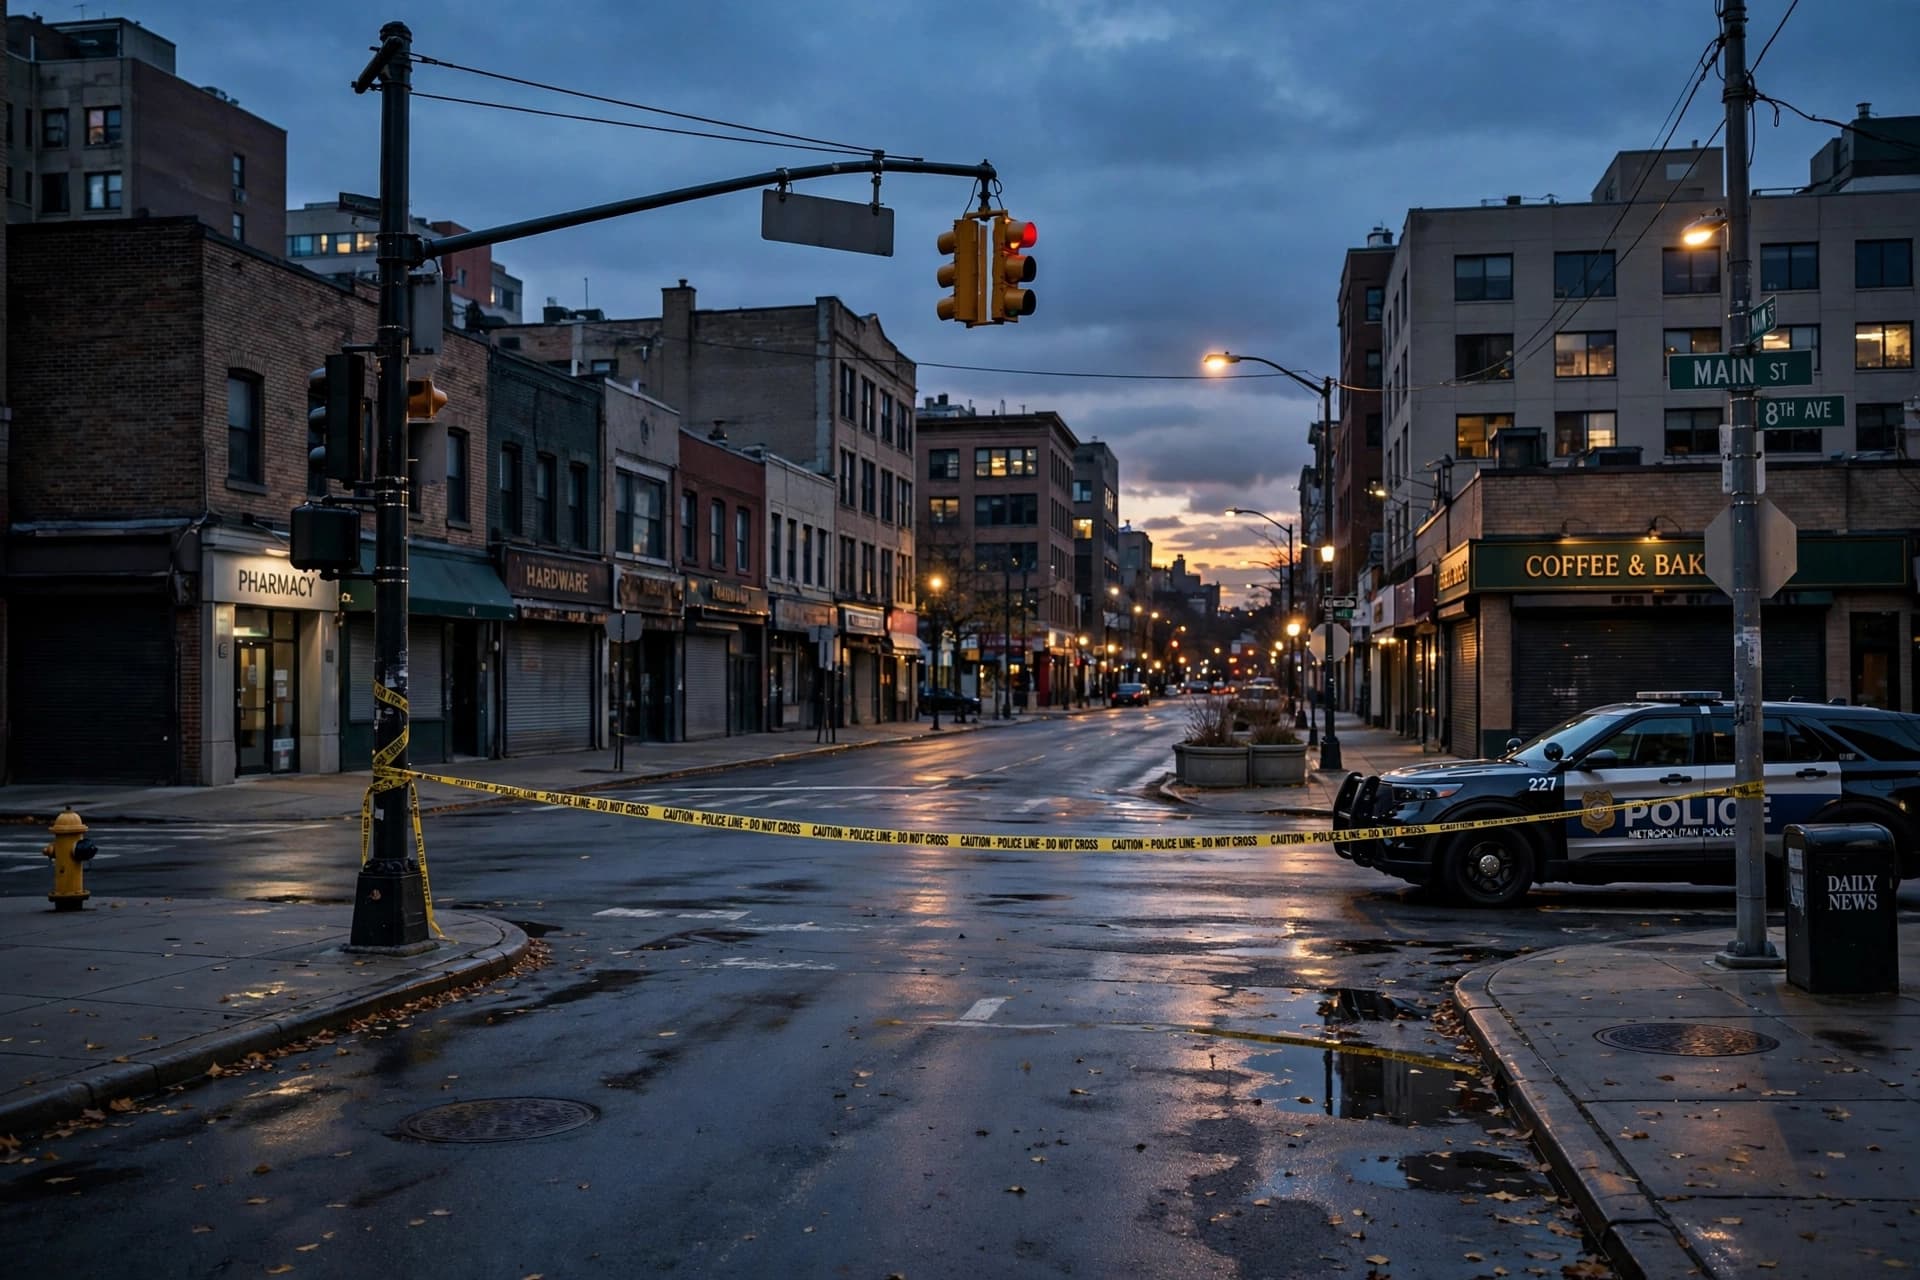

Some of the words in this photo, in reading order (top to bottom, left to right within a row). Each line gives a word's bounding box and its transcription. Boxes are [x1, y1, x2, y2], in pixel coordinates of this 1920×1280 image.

[1694, 358, 1754, 385] MAIN
[1769, 362, 1788, 381] ST
[1765, 401, 1795, 426] 8TH
[1804, 401, 1832, 419] AVE
[1525, 553, 1620, 577] COFFEE
[1627, 553, 1646, 576] &
[1655, 553, 1705, 577] BAK
[238, 569, 315, 597] PHARMACY
[526, 565, 589, 593] HARDWARE
[1528, 777, 1557, 792] 227
[546, 792, 572, 806] POLICE
[574, 796, 590, 808] LINE
[597, 800, 608, 811] DO
[608, 801, 623, 813] NOT
[626, 803, 649, 816] CROSS
[664, 809, 694, 822] CAUTION
[702, 813, 725, 826] POLICE
[728, 816, 743, 828] LINE
[750, 819, 760, 830] DO
[762, 820, 777, 832] NOT
[778, 823, 800, 834] CROSS
[812, 826, 842, 838] CAUTION
[850, 829, 874, 842] POLICE
[876, 831, 891, 842] LINE
[898, 833, 907, 843] DO
[909, 833, 924, 844] NOT
[926, 834, 948, 846] CROSS
[960, 836, 990, 848] CAUTION
[998, 837, 1022, 848] POLICE
[1024, 838, 1040, 849] LINE
[1046, 839, 1056, 849] DO
[1058, 839, 1073, 849] NOT
[1074, 839, 1098, 850] CROSS
[1112, 839, 1143, 850] CAUTION
[1151, 838, 1176, 849] POLICE
[1179, 838, 1195, 848] LINE
[1202, 838, 1212, 848] DO
[1215, 837, 1230, 847] NOT
[1233, 836, 1257, 846] CROSS
[1271, 833, 1304, 844] CAUTION
[1313, 831, 1341, 842] POLICE
[1343, 830, 1360, 841] LINE
[1368, 828, 1380, 838] DO
[1382, 827, 1397, 837] NOT
[1401, 825, 1426, 835] CROSS
[1827, 874, 1878, 892] DAILY
[1828, 894, 1878, 911] NEWS
